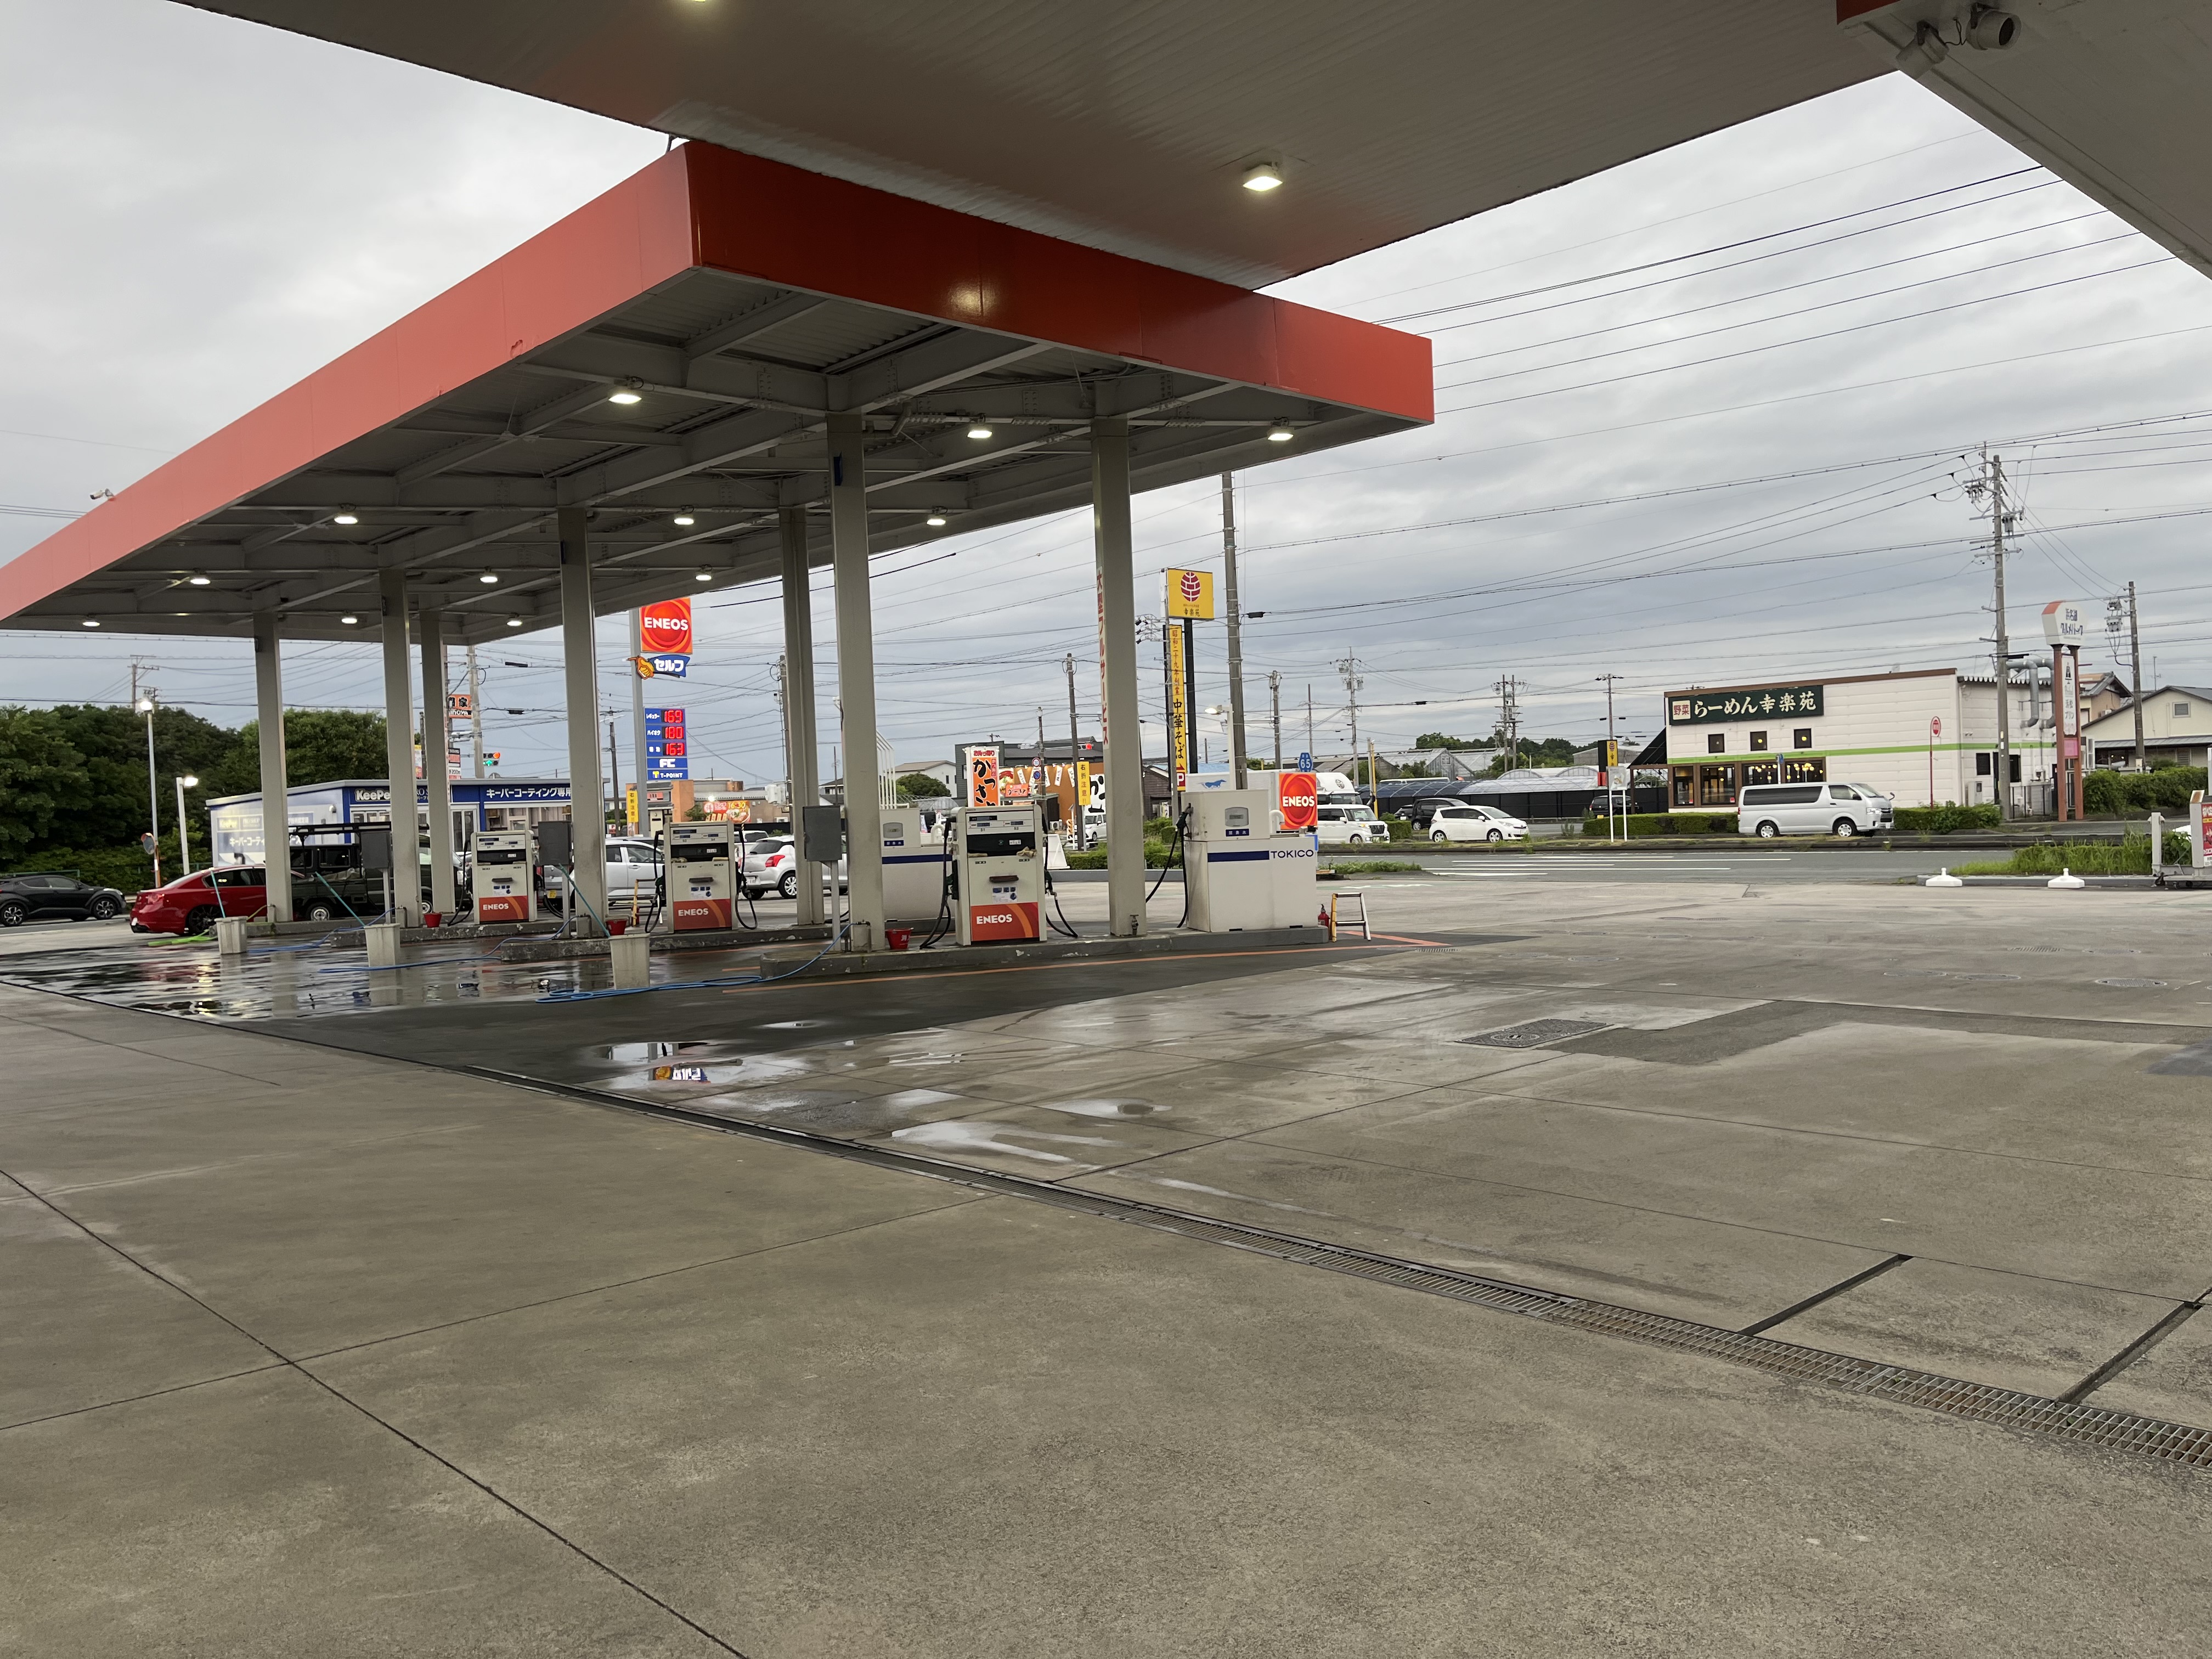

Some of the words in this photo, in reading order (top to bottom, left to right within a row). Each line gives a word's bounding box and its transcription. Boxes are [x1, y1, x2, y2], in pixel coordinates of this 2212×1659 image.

[644, 617, 689, 630] ENEOS
[1097, 570, 1108, 745] 大型フルサービス
[654, 658, 684, 672] セルフ
[1673, 704, 1690, 715] 野菜
[664, 710, 684, 724] 169
[665, 726, 685, 740] 180
[1173, 698, 1185, 759] 中華そば
[666, 743, 685, 756] 163
[659, 758, 676, 768] FC
[1300, 759, 1311, 769] 65
[1177, 772, 1184, 786] P
[356, 789, 391, 800] KeePe
[1282, 796, 1315, 807] ENEOS
[1271, 849, 1314, 859] TOKICO
[678, 908, 709, 917] ENEOS
[976, 914, 1013, 924] ENEOS
